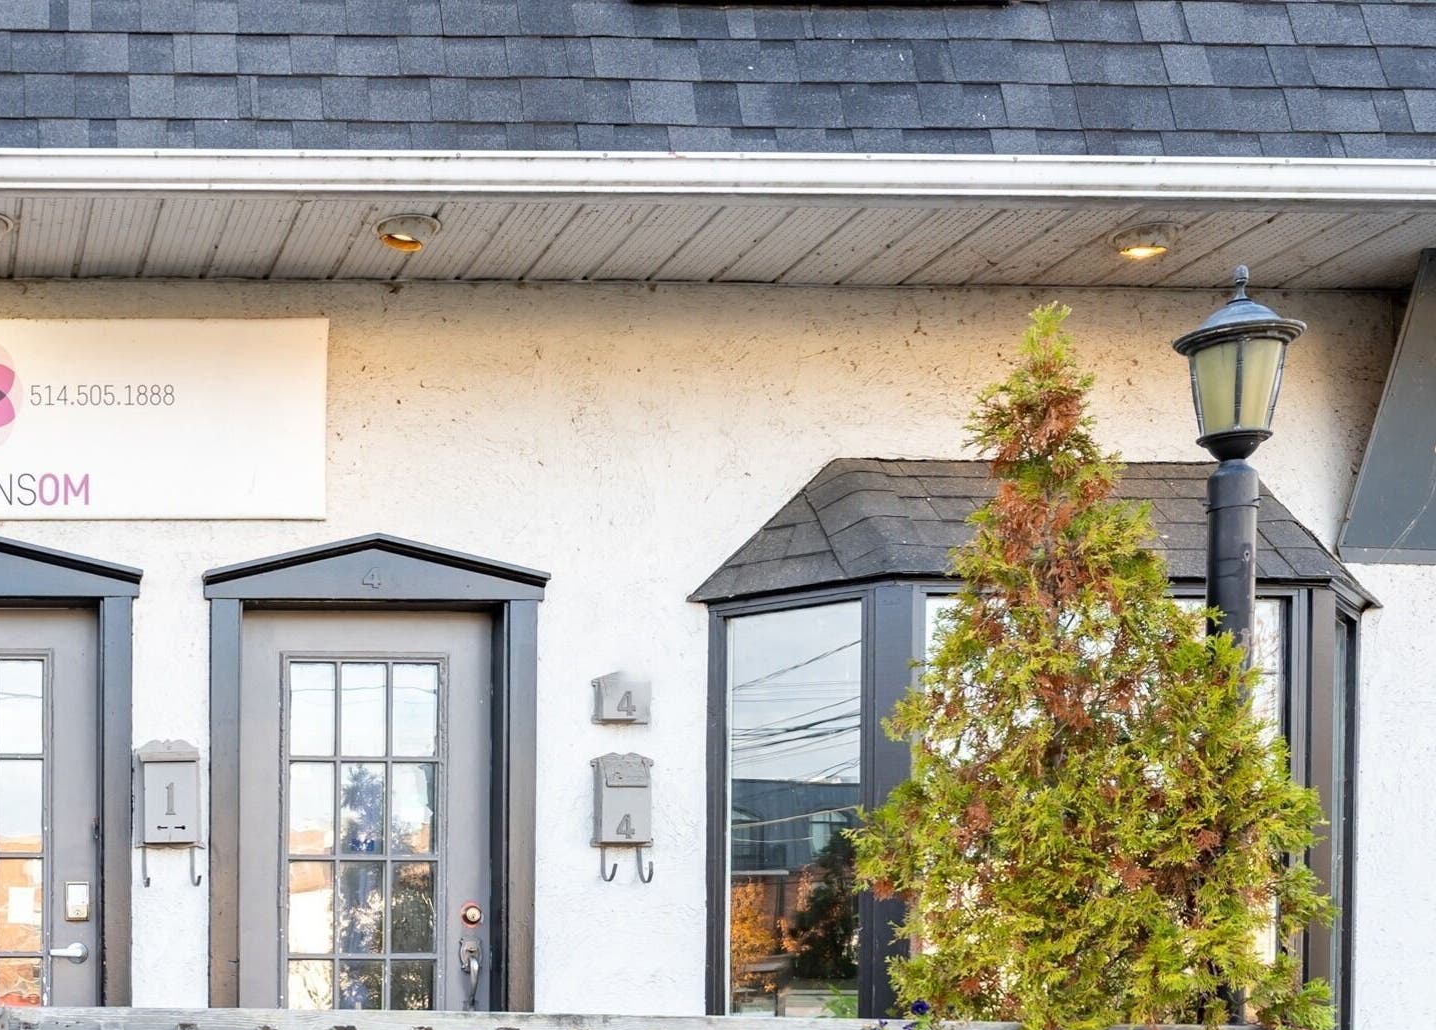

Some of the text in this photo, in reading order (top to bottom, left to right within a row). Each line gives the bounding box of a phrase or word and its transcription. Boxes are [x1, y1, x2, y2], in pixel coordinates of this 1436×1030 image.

[30, 384, 176, 406] 514.505.1888
[617, 690, 637, 717] 4
[165, 782, 177, 816] 1
[615, 813, 636, 840] 4
